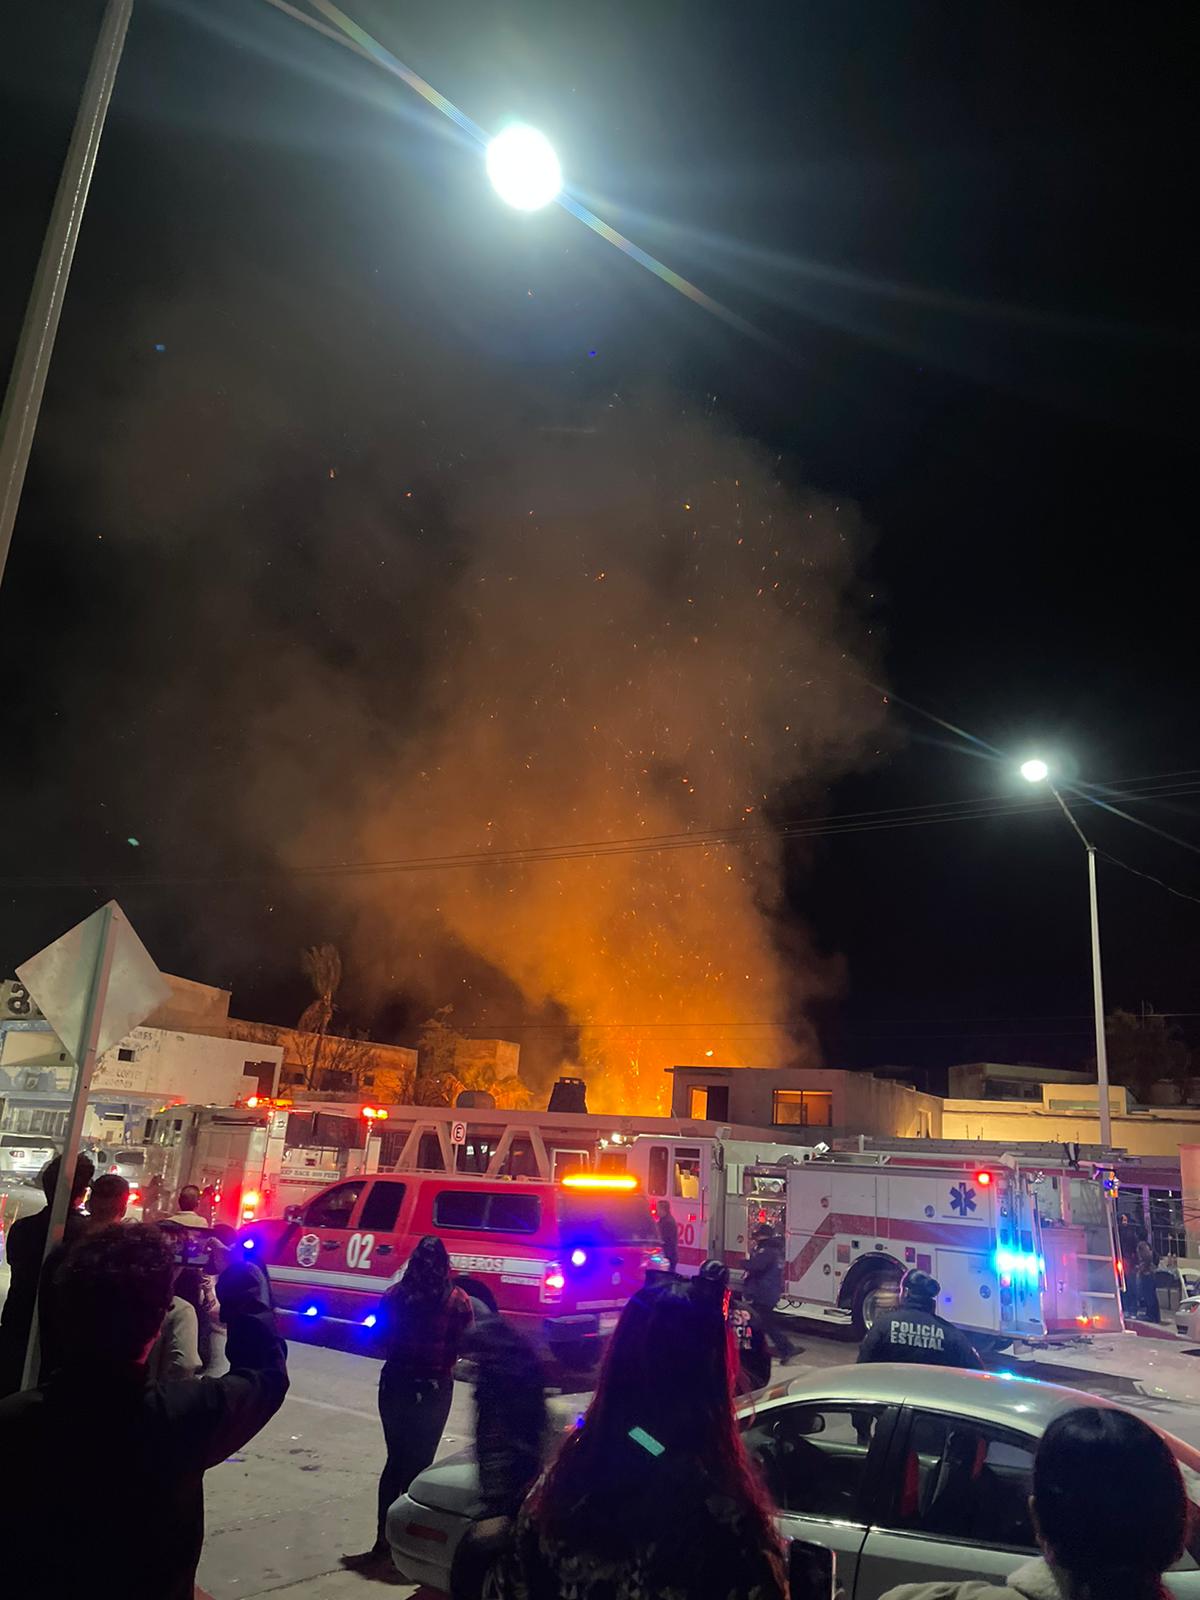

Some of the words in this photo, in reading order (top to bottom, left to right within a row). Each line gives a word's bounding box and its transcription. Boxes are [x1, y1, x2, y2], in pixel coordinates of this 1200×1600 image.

[346, 1233, 374, 1269] 02
[449, 1255, 503, 1272] MBEROS
[890, 1320, 944, 1340] POLICÍA
[890, 1331, 944, 1351] ESTATAL
